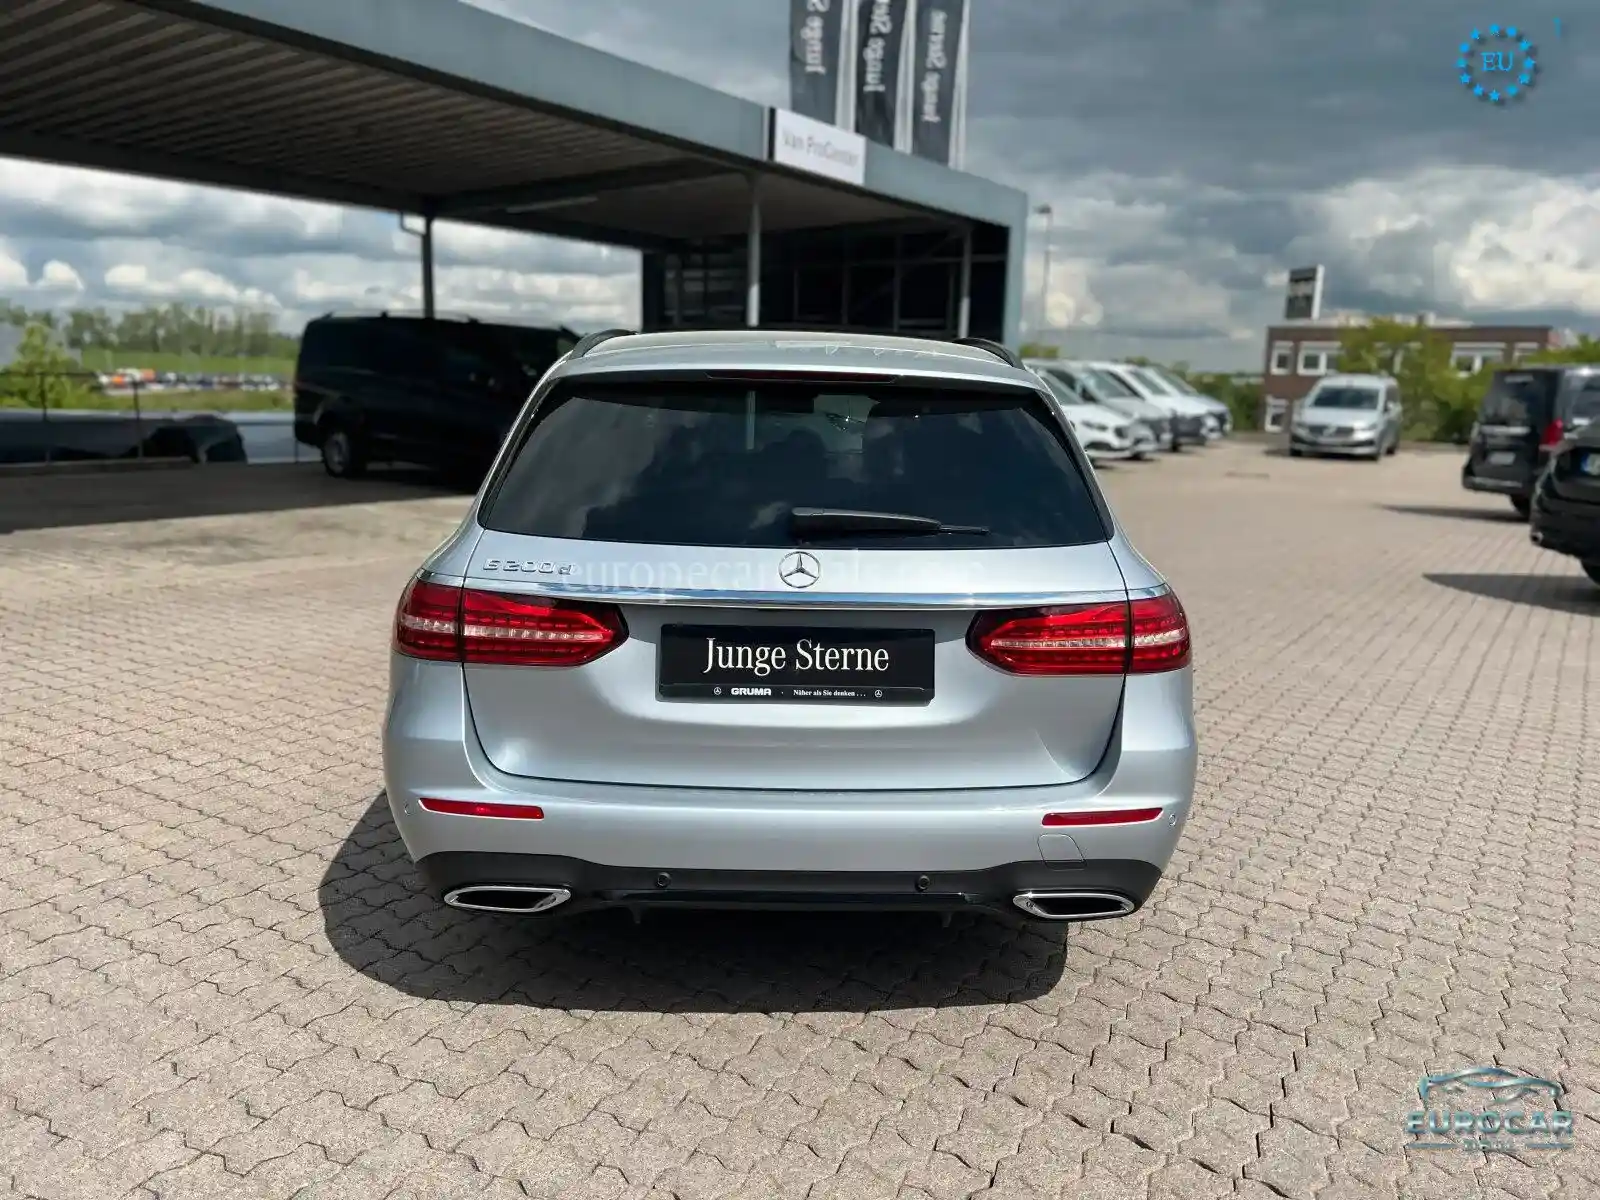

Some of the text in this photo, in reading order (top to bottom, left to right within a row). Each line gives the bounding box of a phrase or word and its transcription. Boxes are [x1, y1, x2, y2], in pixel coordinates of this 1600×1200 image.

[703, 637, 889, 677] Junge Sterne
[730, 687, 772, 696] GRUMA
